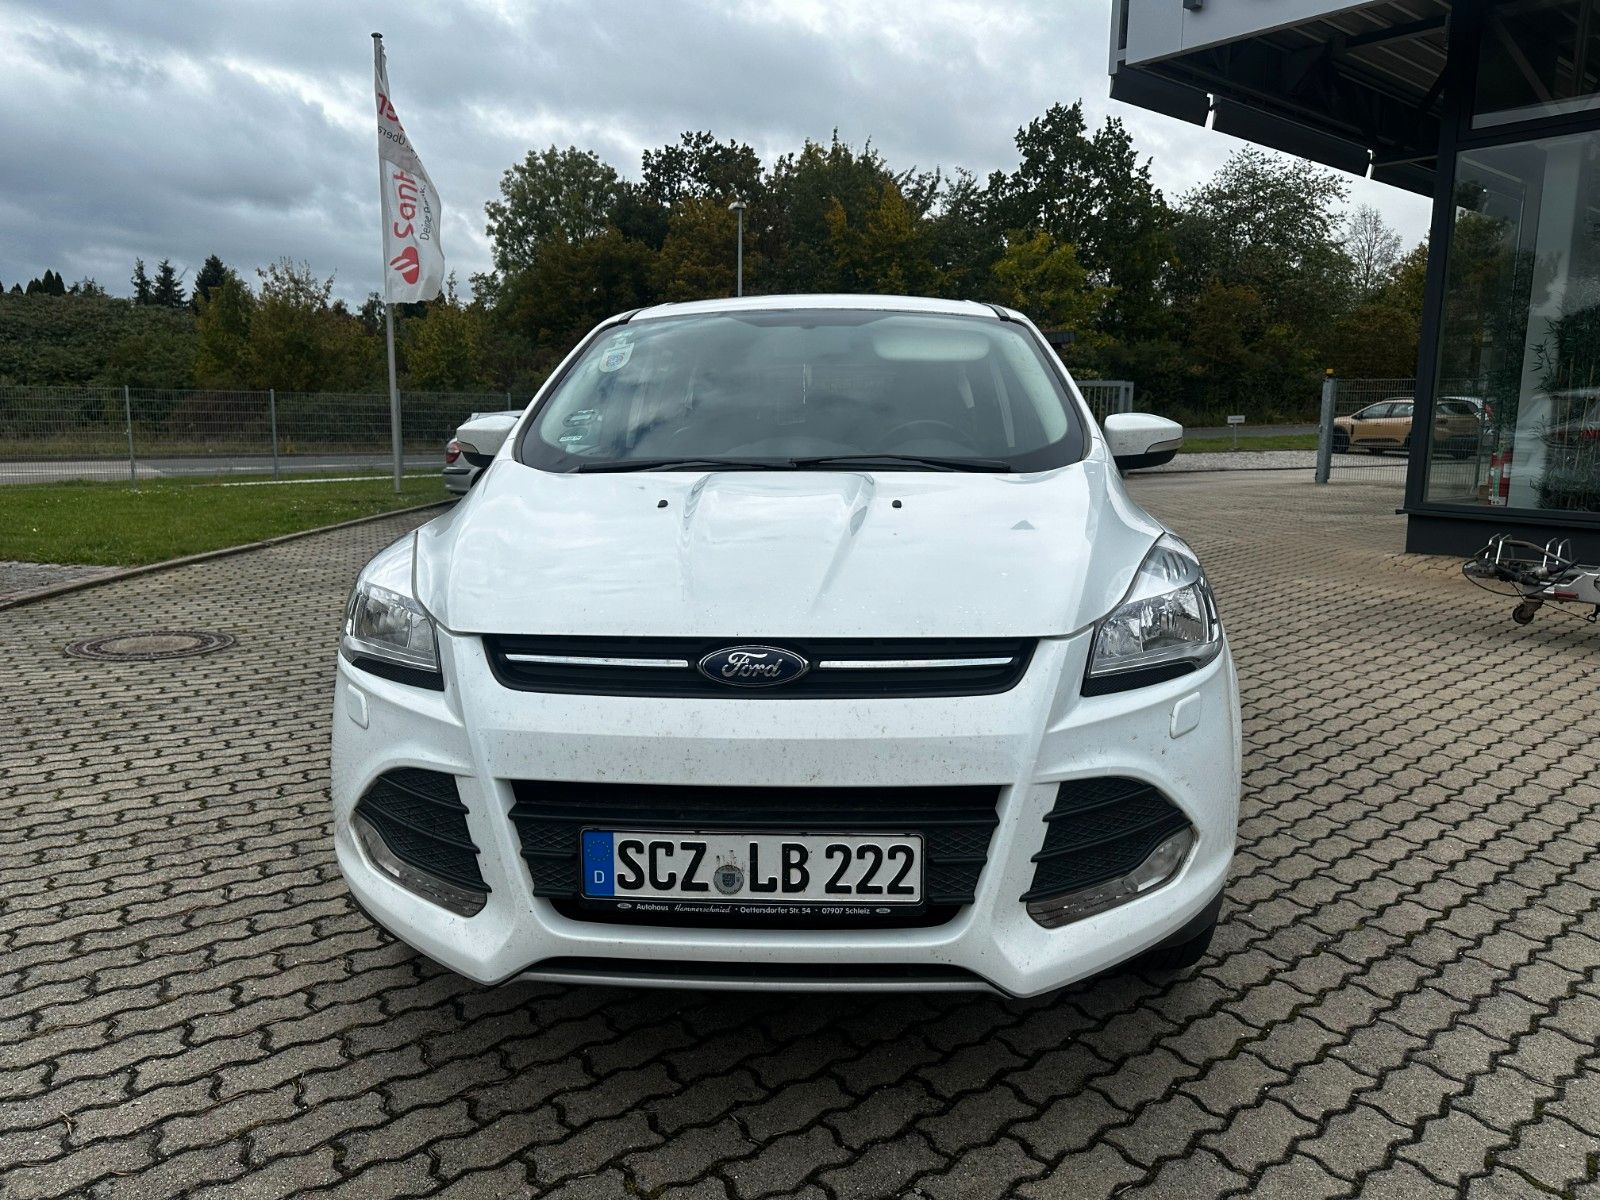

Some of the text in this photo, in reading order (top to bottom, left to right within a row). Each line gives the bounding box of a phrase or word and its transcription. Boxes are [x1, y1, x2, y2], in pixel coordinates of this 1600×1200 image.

[721, 651, 783, 678] Ford
[594, 870, 605, 884] D
[617, 839, 915, 895] SCZ LB 222
[636, 903, 669, 912] Autohaus
[740, 906, 787, 915] Oettersdorfer
[789, 907, 801, 915] Str.
[801, 907, 811, 915] 54
[821, 908, 844, 916] 07907
[845, 908, 871, 917] Schleiz
